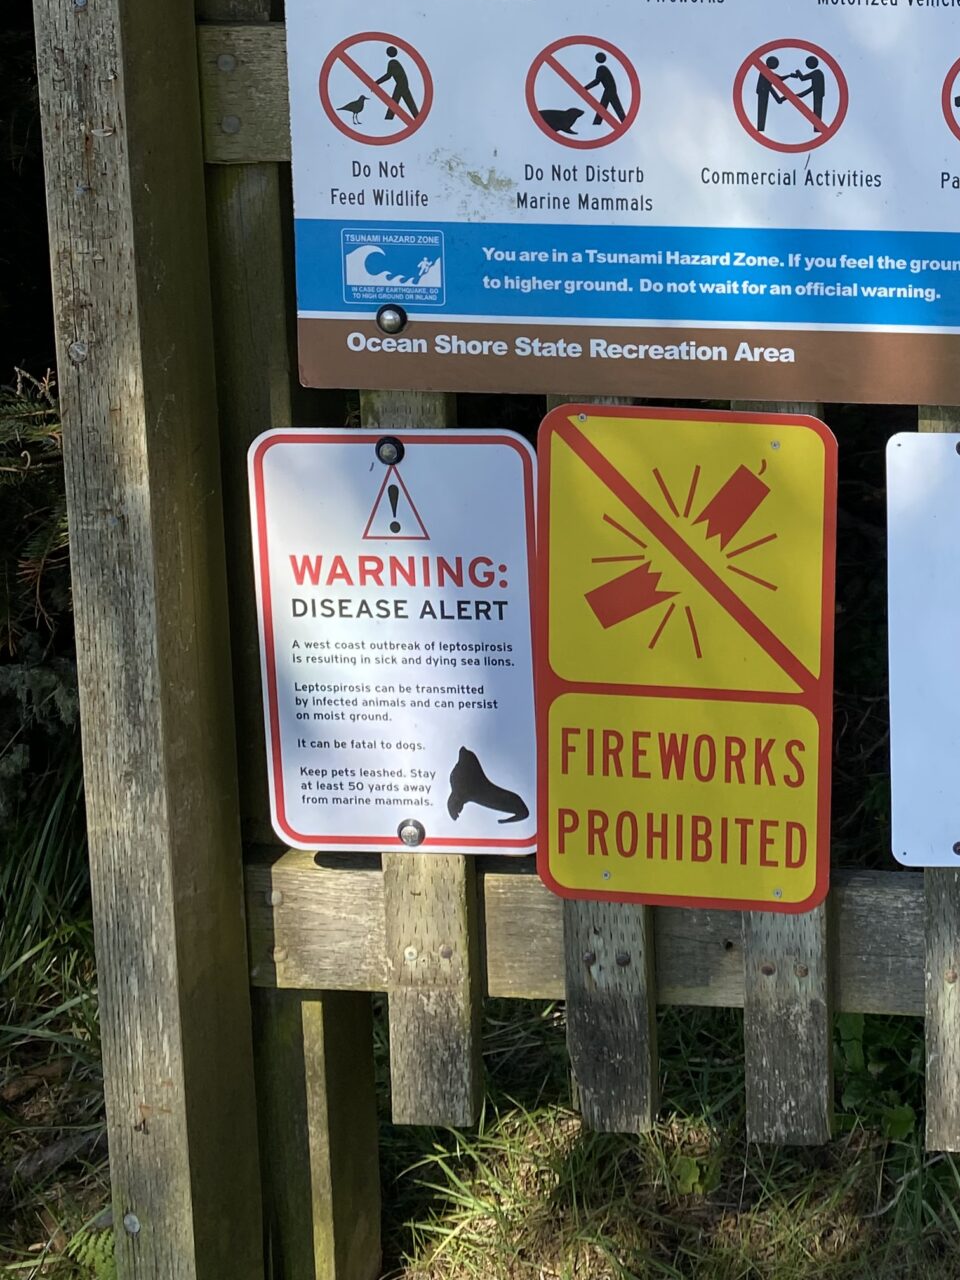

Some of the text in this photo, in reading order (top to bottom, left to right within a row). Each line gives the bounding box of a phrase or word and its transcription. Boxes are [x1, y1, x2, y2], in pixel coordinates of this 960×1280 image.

[352, 160, 404, 178] Do Not
[524, 164, 643, 182] Do Not Disturb
[701, 167, 881, 187] Commercial Activities
[330, 188, 428, 206] Feed Wildlife
[516, 191, 652, 211] Marine Mammals
[344, 234, 440, 245] TSUNAMI HAZARD ZONE
[482, 246, 516, 261] You
[518, 250, 549, 262] are
[552, 248, 568, 262] in
[571, 252, 582, 262] a
[584, 249, 662, 264] Tsunami
[666, 250, 730, 266] Hazard
[732, 252, 784, 267] Zone.
[788, 253, 801, 267] If
[804, 257, 836, 270] you
[839, 254, 873, 269] feel
[876, 255, 907, 269] the
[346, 332, 795, 362] Ocean Shore State Recreation Area
[289, 554, 508, 589] WARNING:
[291, 598, 508, 620] DISEASE ALERT
[297, 738, 426, 751] It can be fatal to dogs.
[561, 727, 806, 788] FIREWORKS
[299, 766, 436, 780] Keep pets leashed. Stay
[557, 808, 808, 869] PROHIBITED
